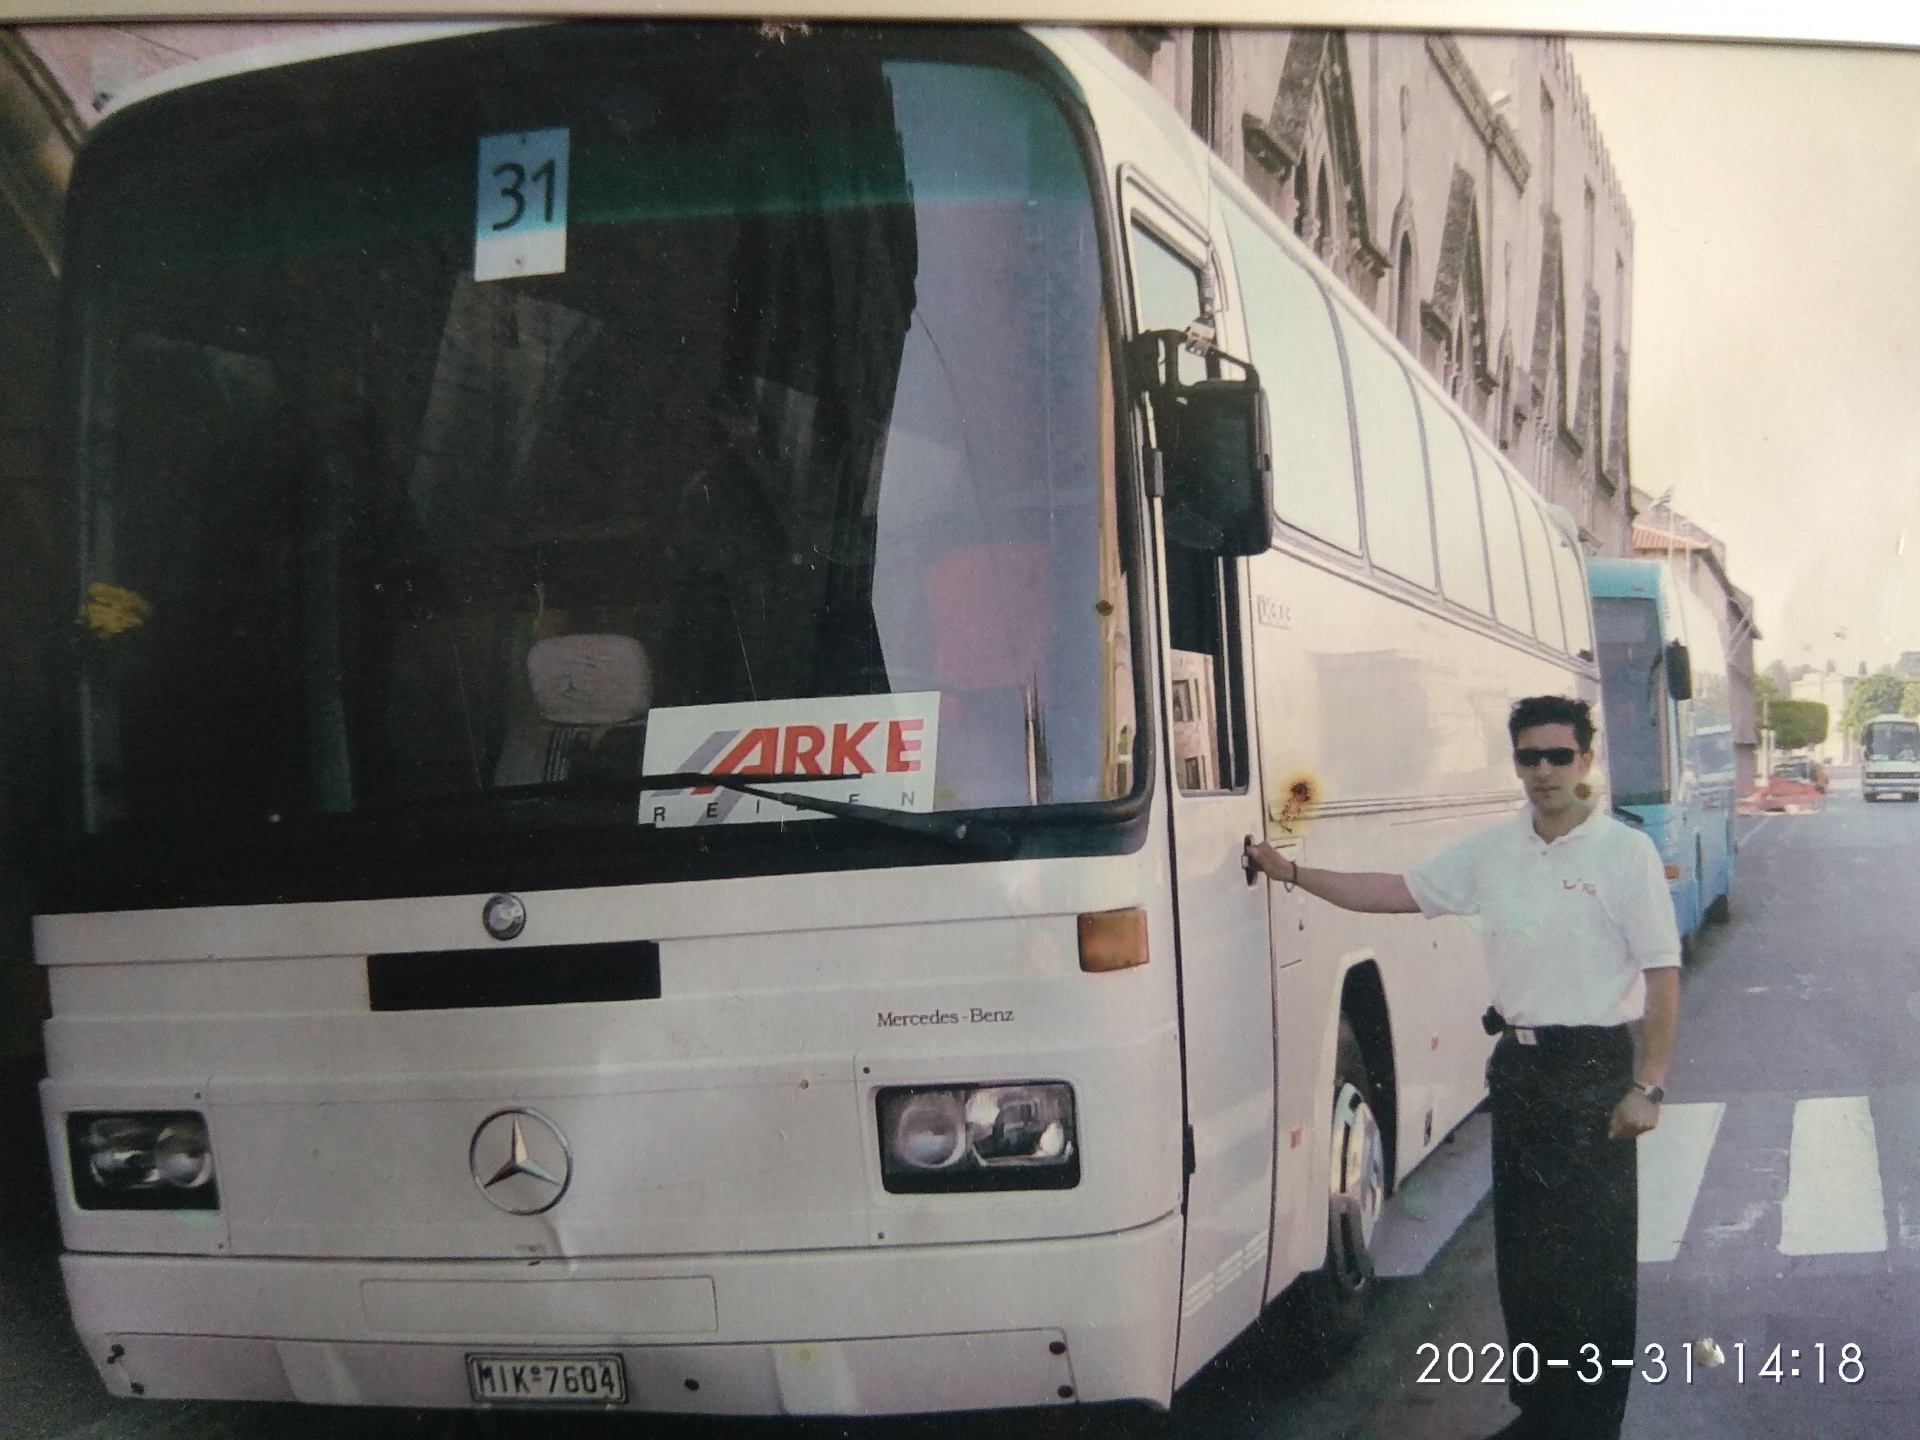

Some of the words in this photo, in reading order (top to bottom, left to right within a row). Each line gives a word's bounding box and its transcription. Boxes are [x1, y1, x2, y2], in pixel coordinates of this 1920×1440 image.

[493, 157, 556, 231] 31
[690, 719, 925, 795] ARKE
[653, 791, 916, 822] REIEN
